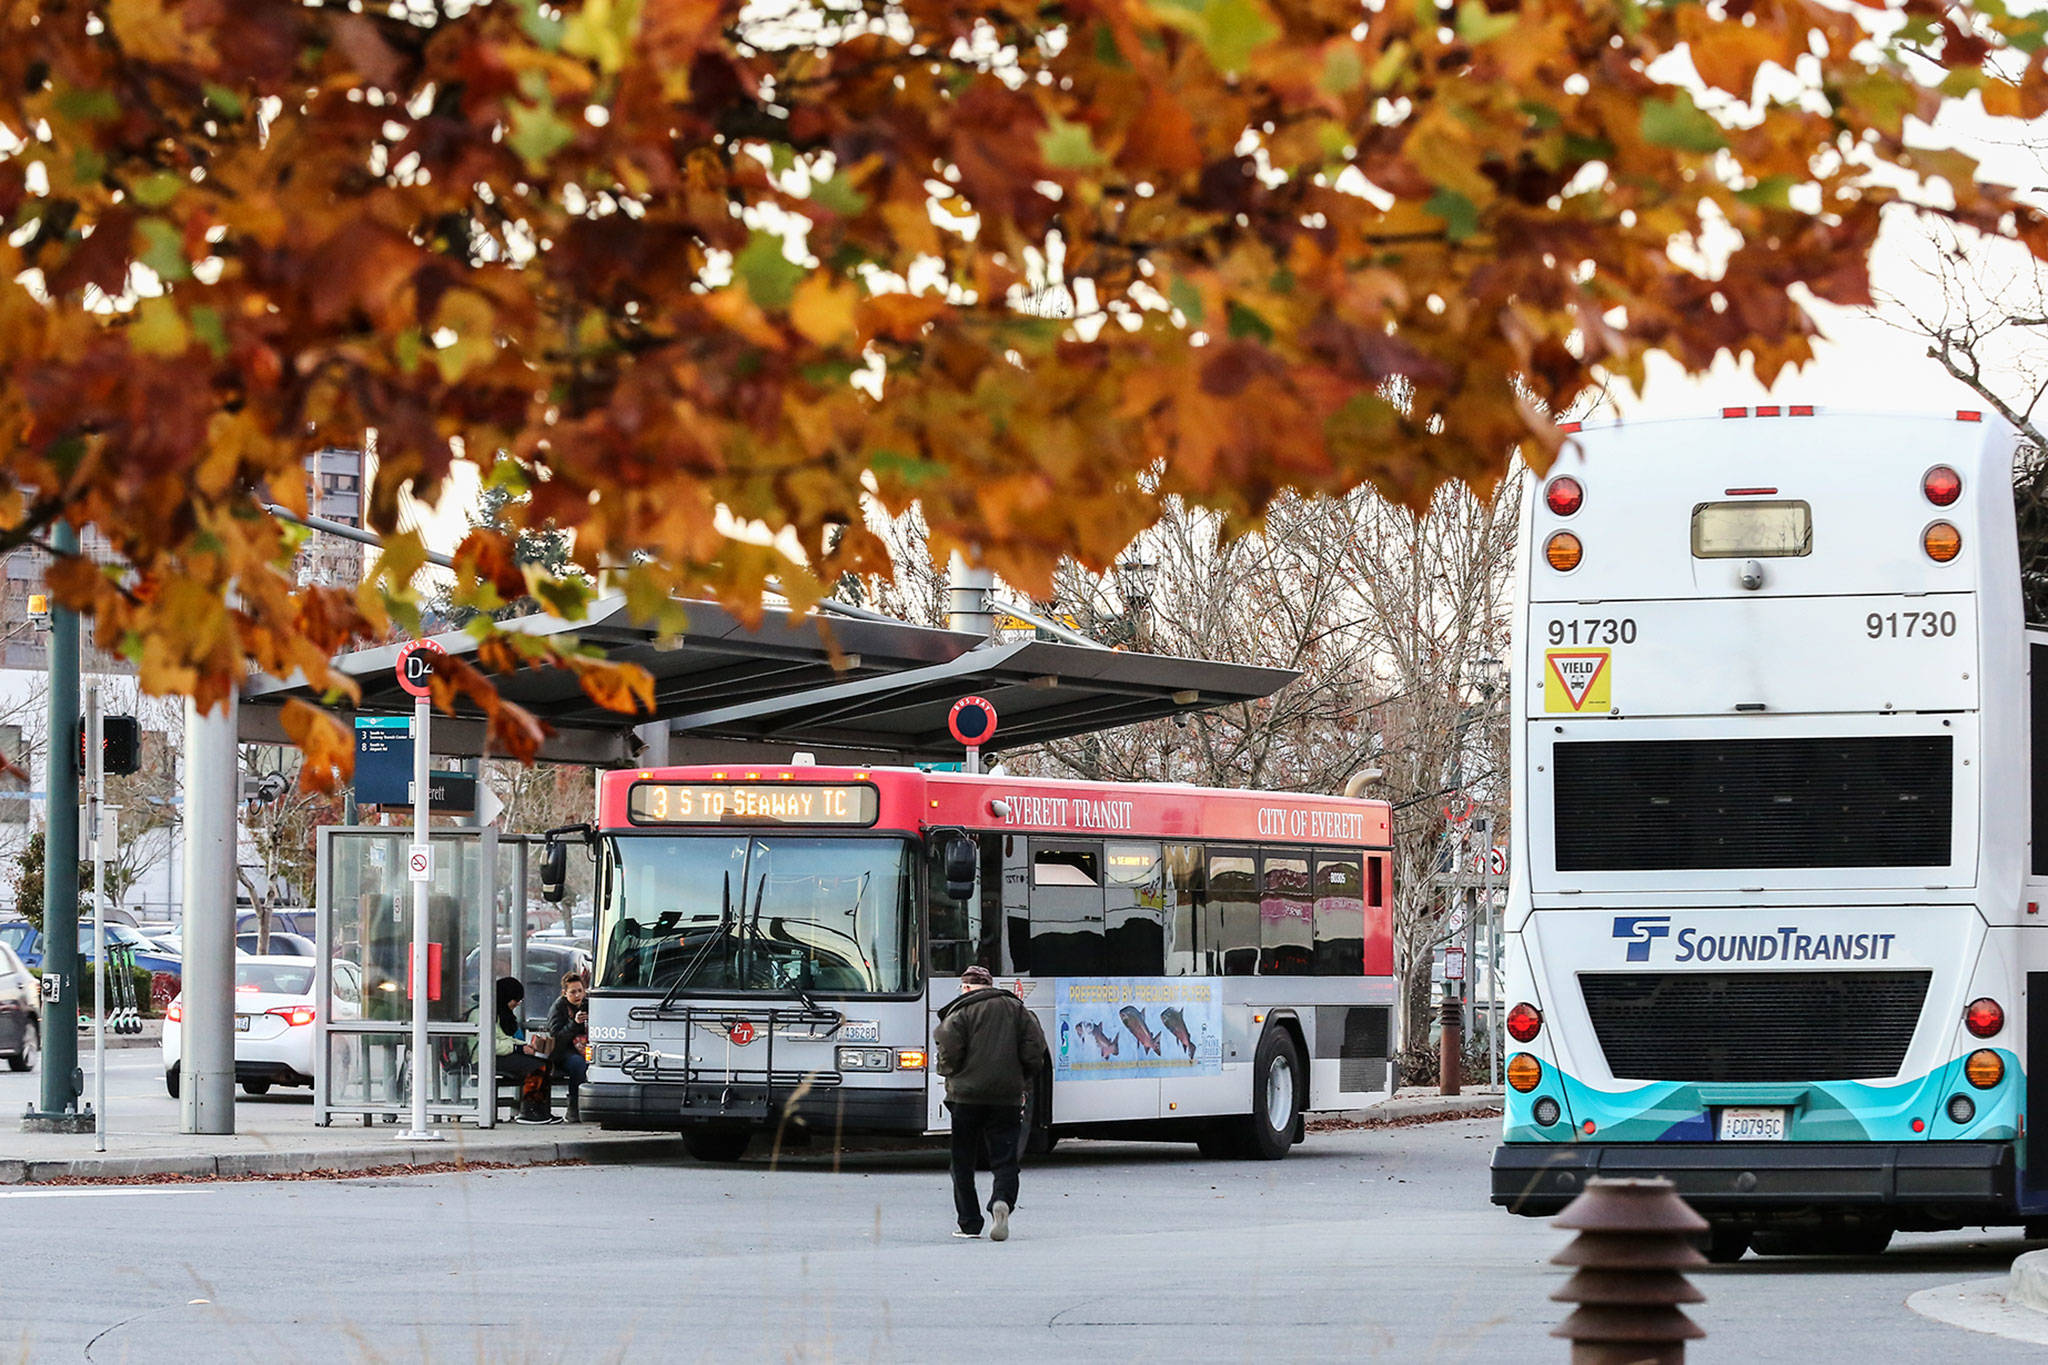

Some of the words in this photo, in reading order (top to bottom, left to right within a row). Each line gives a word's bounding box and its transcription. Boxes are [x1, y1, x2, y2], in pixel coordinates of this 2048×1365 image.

[1548, 618, 1637, 645] 91730
[1866, 610, 1957, 639] 91730
[402, 641, 420, 655] BUS
[1561, 662, 1594, 674] YIELD
[954, 698, 970, 711] BUS
[975, 698, 991, 711] BAY
[361, 730, 368, 740] 3
[361, 742, 368, 752] 8
[653, 786, 668, 819] 3
[680, 789, 692, 815] S
[733, 789, 813, 816] SEAWAY
[823, 789, 848, 816] TC
[1004, 795, 1069, 826] EVERETT
[1072, 798, 1134, 829] TRANSIT
[1257, 807, 1287, 835] CITY
[1291, 809, 1309, 837] OF
[1311, 810, 1364, 840] EVERETT
[1069, 984, 1119, 1003] PREFERRED
[1122, 985, 1132, 1002] BY
[1135, 985, 1179, 1002] FREQUENT
[1182, 984, 1211, 1001] FLYERS
[1732, 1119, 1781, 1135] C0795C
